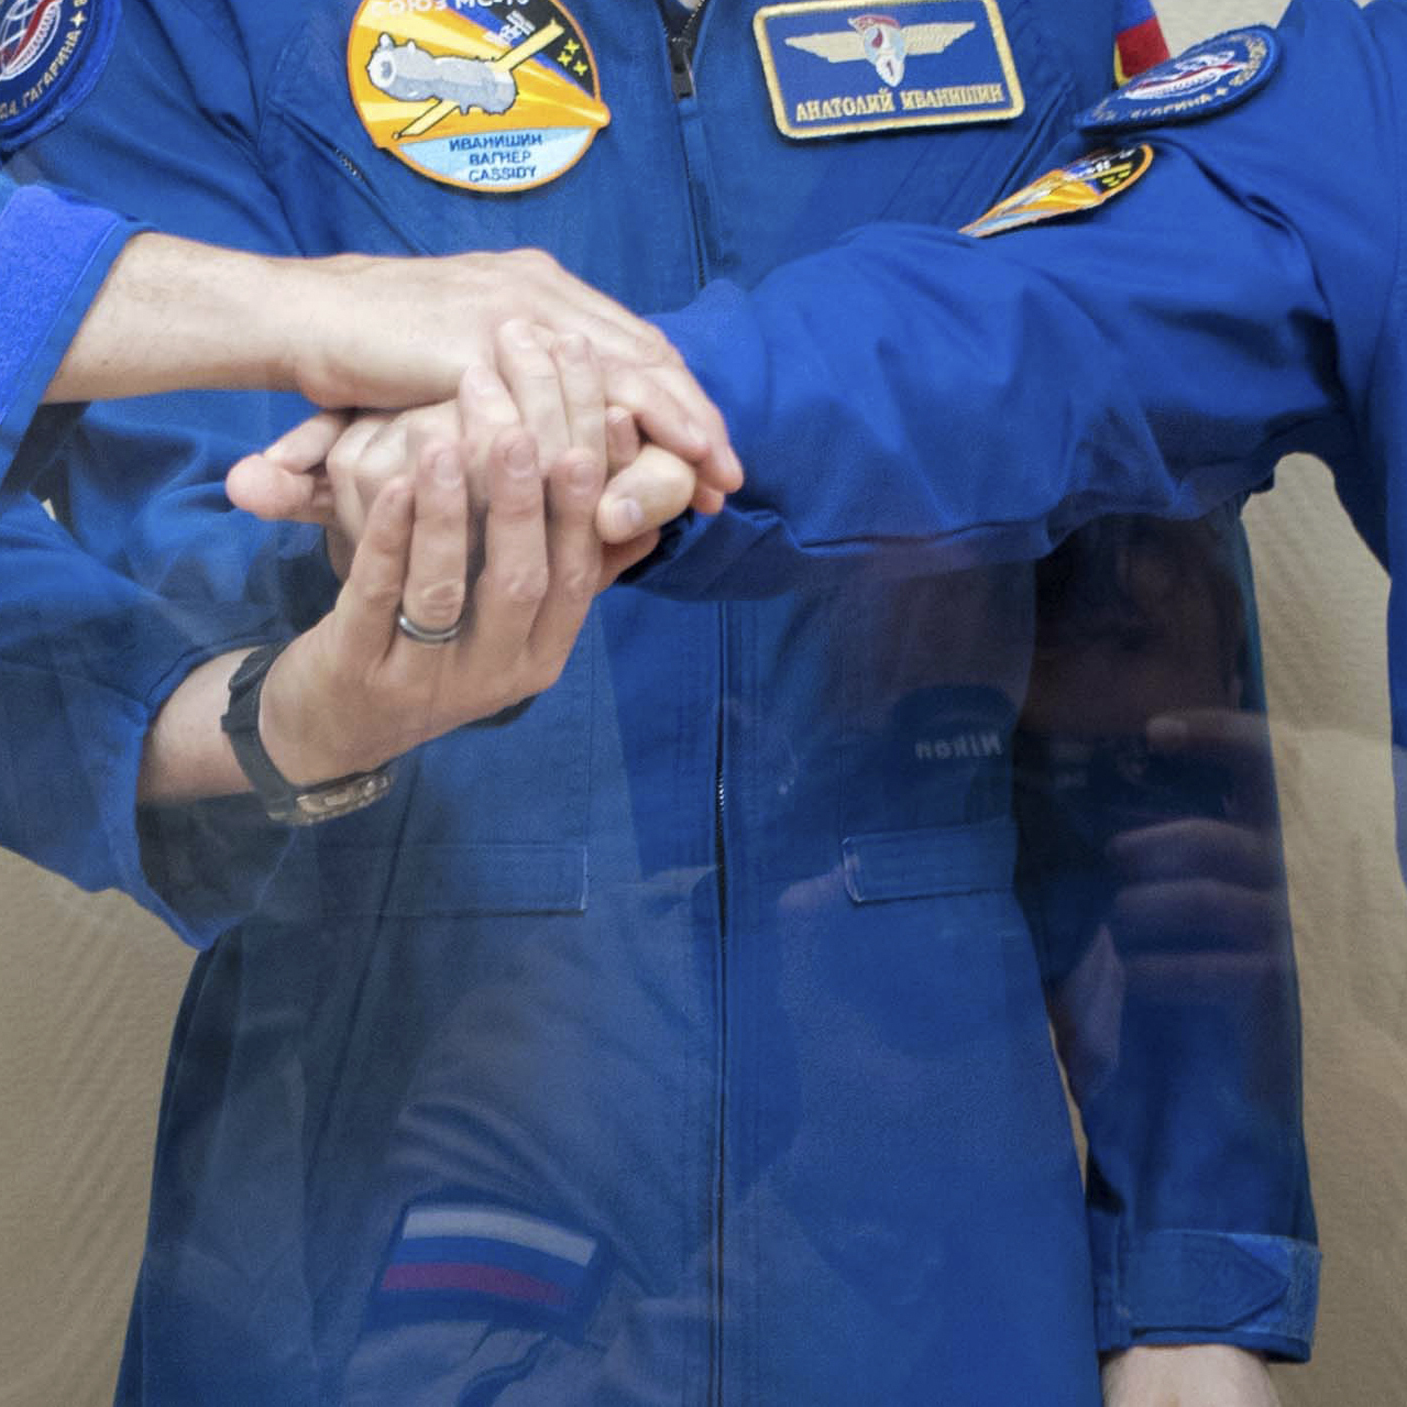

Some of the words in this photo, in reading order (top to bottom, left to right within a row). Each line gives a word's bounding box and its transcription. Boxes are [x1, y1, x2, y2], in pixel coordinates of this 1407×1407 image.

[796, 88, 894, 122] АНАТОЛИЙ
[900, 83, 1005, 111] ИВАНИШИН
[448, 133, 543, 152] ИВАНИШИН
[468, 150, 532, 167] ВАГНЕР
[468, 165, 537, 183] CASSIDY
